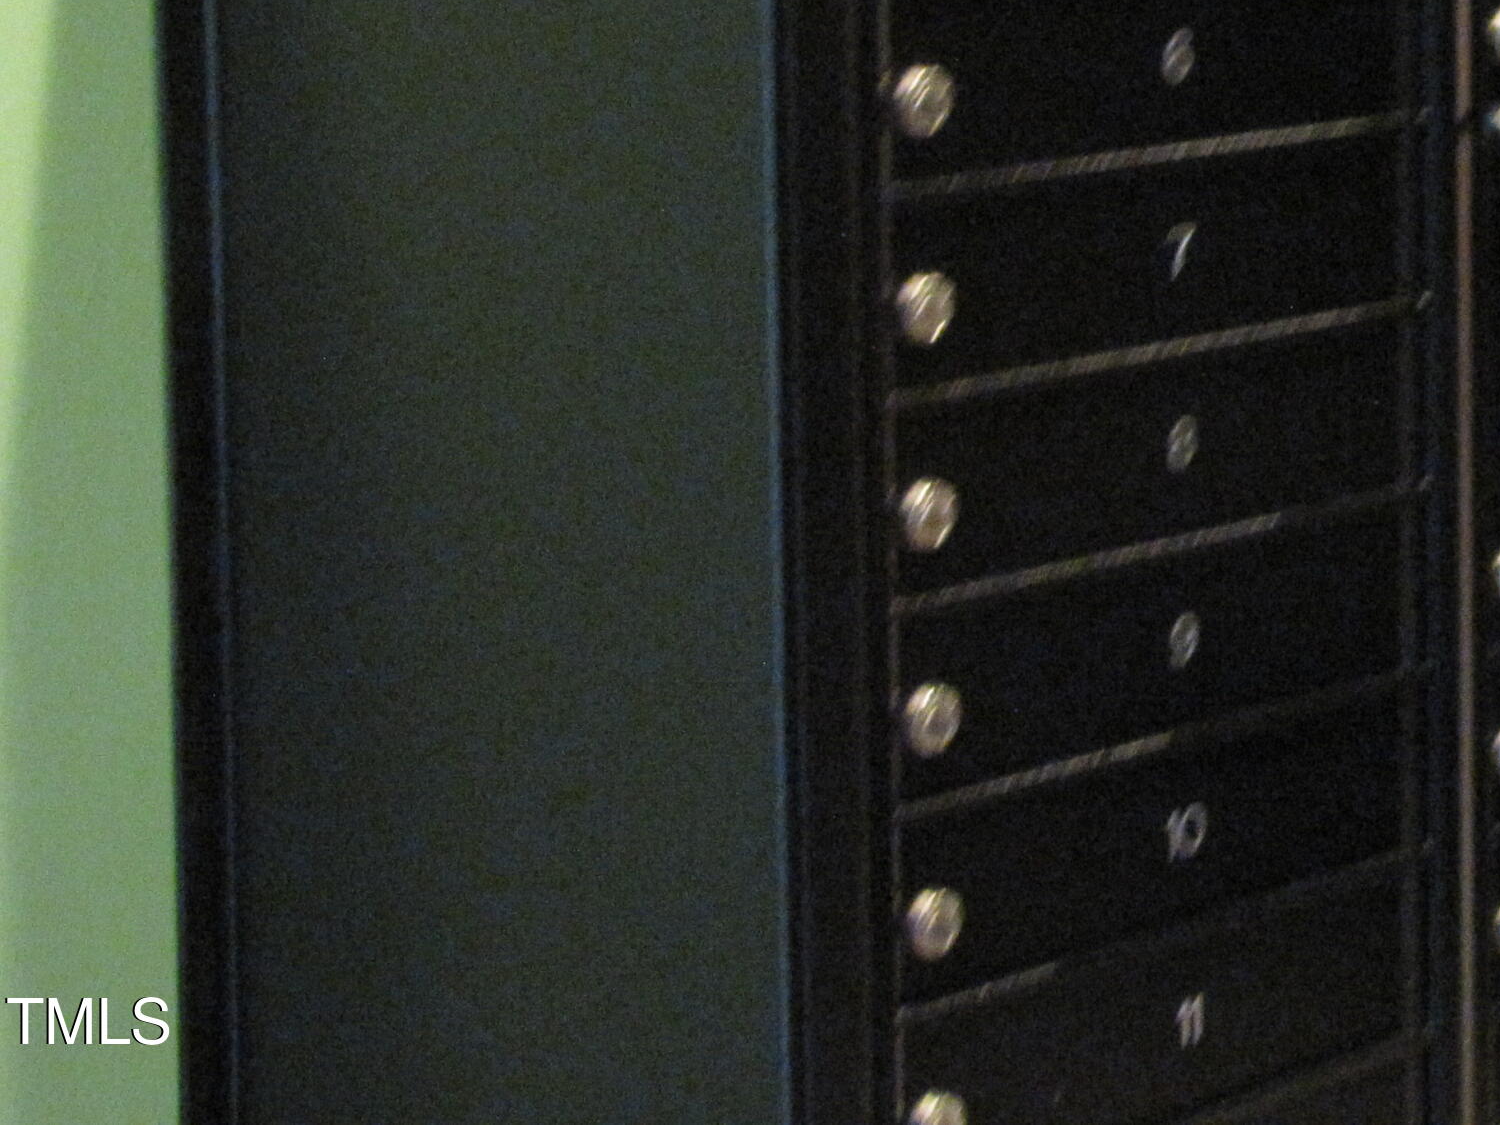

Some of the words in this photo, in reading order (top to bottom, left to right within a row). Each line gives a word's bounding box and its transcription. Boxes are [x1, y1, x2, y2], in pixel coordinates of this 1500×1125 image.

[1161, 27, 1195, 85] 6
[1165, 221, 1198, 281] 7
[1164, 802, 1208, 861] 10
[1172, 990, 1205, 1051] 11
